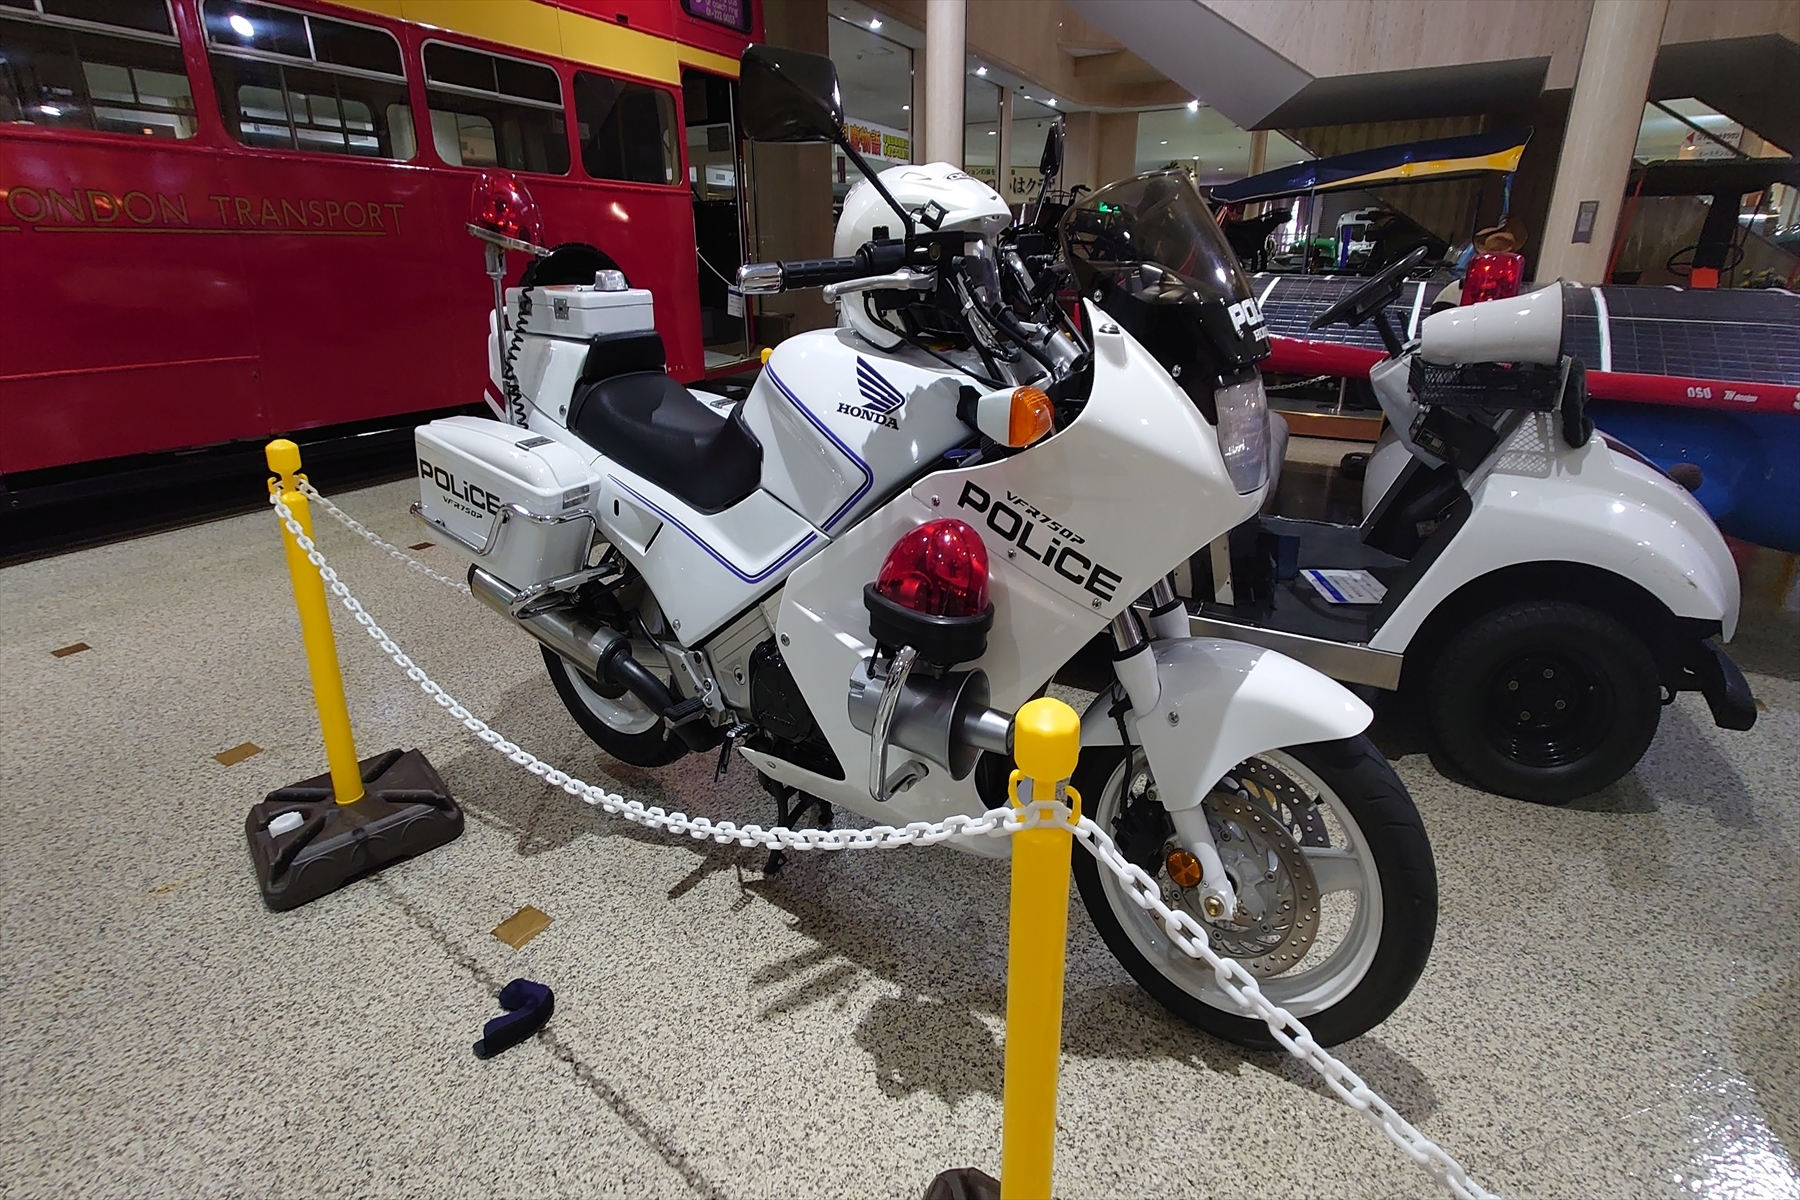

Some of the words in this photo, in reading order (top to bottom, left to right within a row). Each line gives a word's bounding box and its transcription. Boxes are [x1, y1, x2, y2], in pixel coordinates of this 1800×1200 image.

[7, 186, 190, 226] ONDON
[210, 195, 404, 235] TRANSPORT
[1227, 297, 1265, 331] POL
[836, 402, 900, 431] HONDA
[442, 495, 483, 520] VFR750P
[1006, 490, 1086, 545] VFR750P
